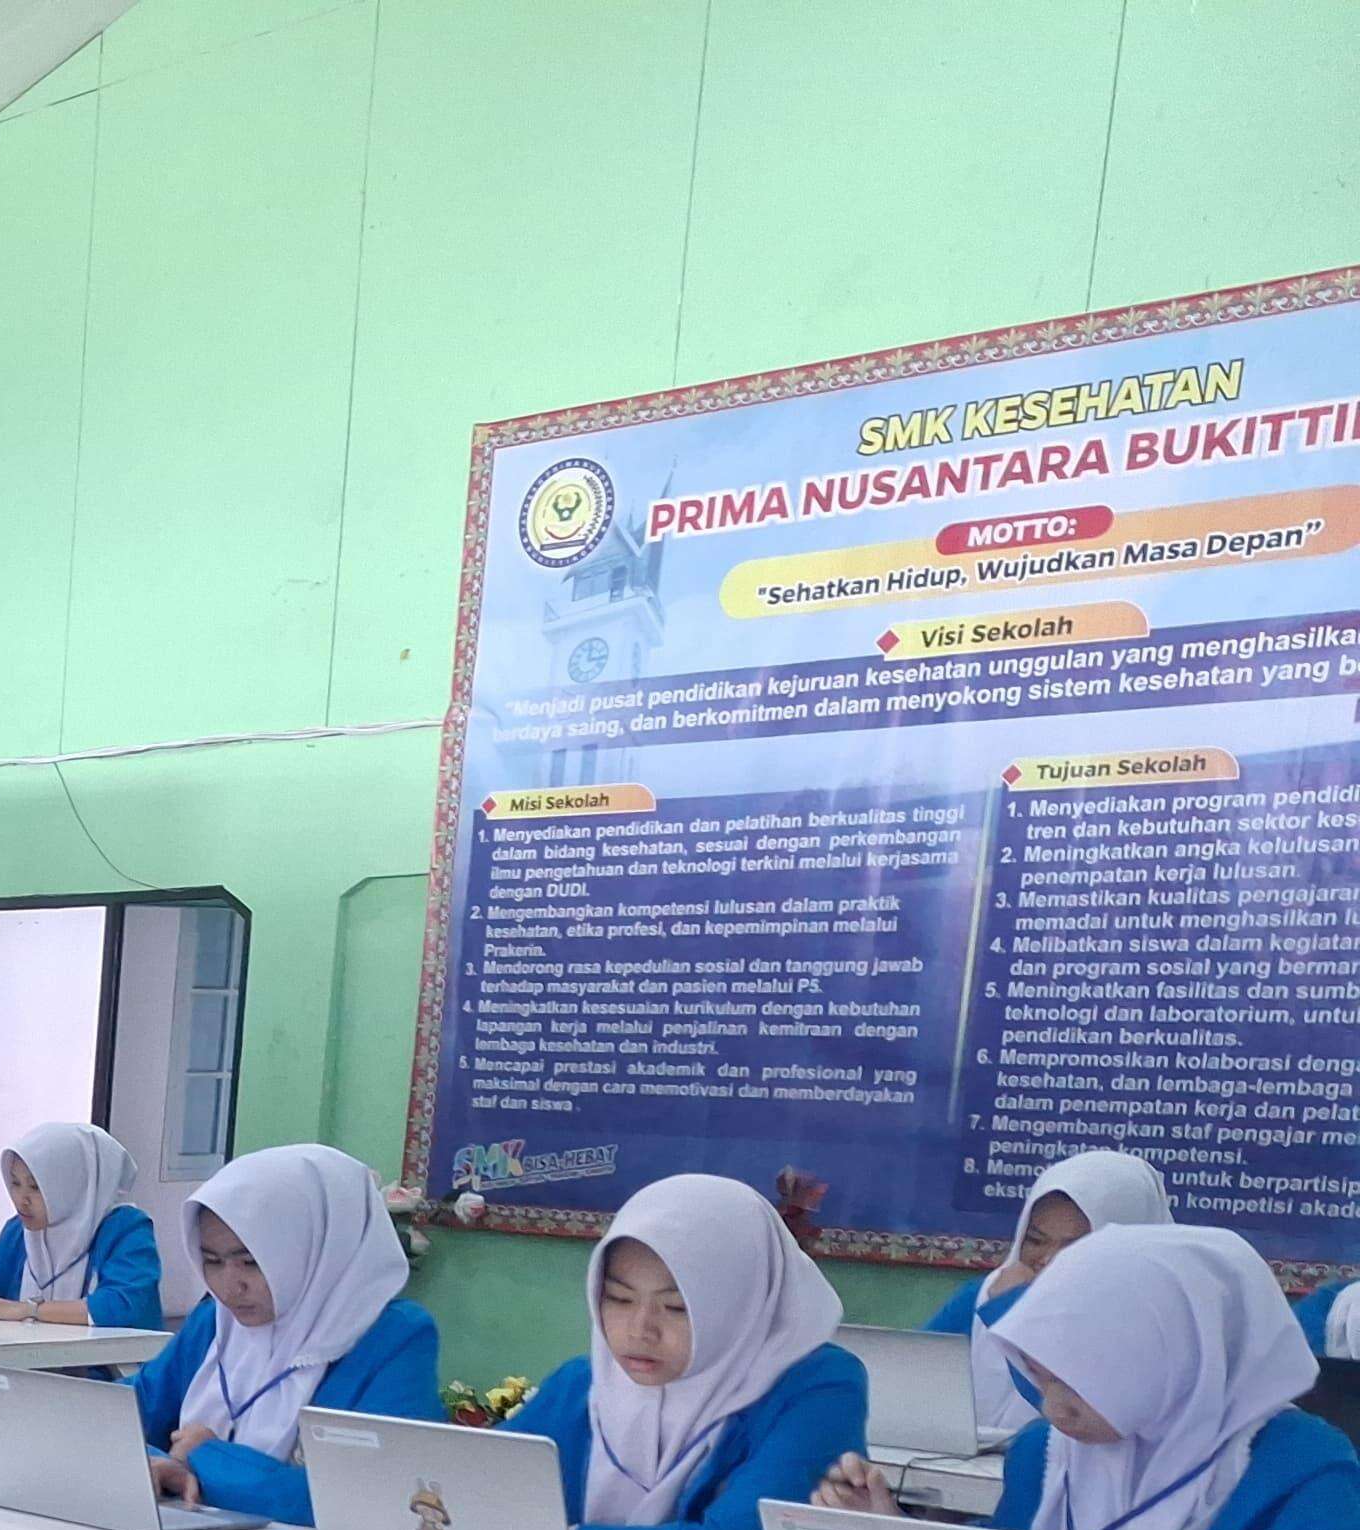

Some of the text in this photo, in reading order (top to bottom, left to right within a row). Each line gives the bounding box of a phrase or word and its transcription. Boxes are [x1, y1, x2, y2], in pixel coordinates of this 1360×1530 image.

[858, 359, 1244, 454] SMK KESEHATAN
[650, 484, 788, 537] PRIMA
[803, 439, 1109, 515] NUSANTARA
[967, 515, 1077, 547] MOTTO:
[886, 566, 967, 594] Hidup,
[977, 549, 1115, 582] Wujudkan
[1123, 542, 1198, 565] Masa
[921, 616, 1073, 648] Visi Sekolah
[589, 690, 644, 714] pusat
[648, 681, 762, 707] pendidikan
[767, 672, 859, 698] kejuruan
[866, 660, 980, 688] kesehatan
[988, 649, 1104, 680] unggulan
[1111, 643, 1173, 669] yang
[1180, 627, 1360, 662] menghasilka
[567, 715, 625, 738] saing,
[629, 712, 667, 731] dan
[673, 702, 809, 728] berkomitmen
[814, 696, 880, 718] dalam
[886, 683, 1021, 714] menyokong
[1028, 674, 1110, 700] sistem
[1117, 662, 1252, 693] kesehatan
[1262, 659, 1329, 686] yang
[1036, 755, 1207, 782] Tujuan Sekolah
[510, 793, 610, 812] Misi Sekolah
[1006, 801, 1022, 818] 1.
[1029, 795, 1166, 822] Menyediakan
[1171, 791, 1267, 816] program
[493, 826, 591, 844] Menyediakan
[596, 822, 683, 840] pendidikan
[690, 819, 719, 833] dan
[725, 815, 802, 834] pelatihan
[808, 809, 906, 828] berkualitas
[913, 804, 965, 825] tinggi
[1027, 814, 1310, 840] tren dan kebutuhan sektor
[492, 829, 961, 861] dalam bidang kesehatan, sesuai dengan perkembangan
[1000, 847, 1017, 864] 2.
[1024, 841, 1168, 866] Meningkatkan
[1174, 841, 1241, 861] angka
[1020, 868, 1148, 890] penempatan
[1154, 864, 1206, 884] kerja
[487, 904, 613, 922] Mengembangkan
[618, 900, 709, 920] kompetensi
[714, 898, 776, 914] lulusan
[781, 897, 833, 914] dalam
[838, 895, 900, 915] praktik
